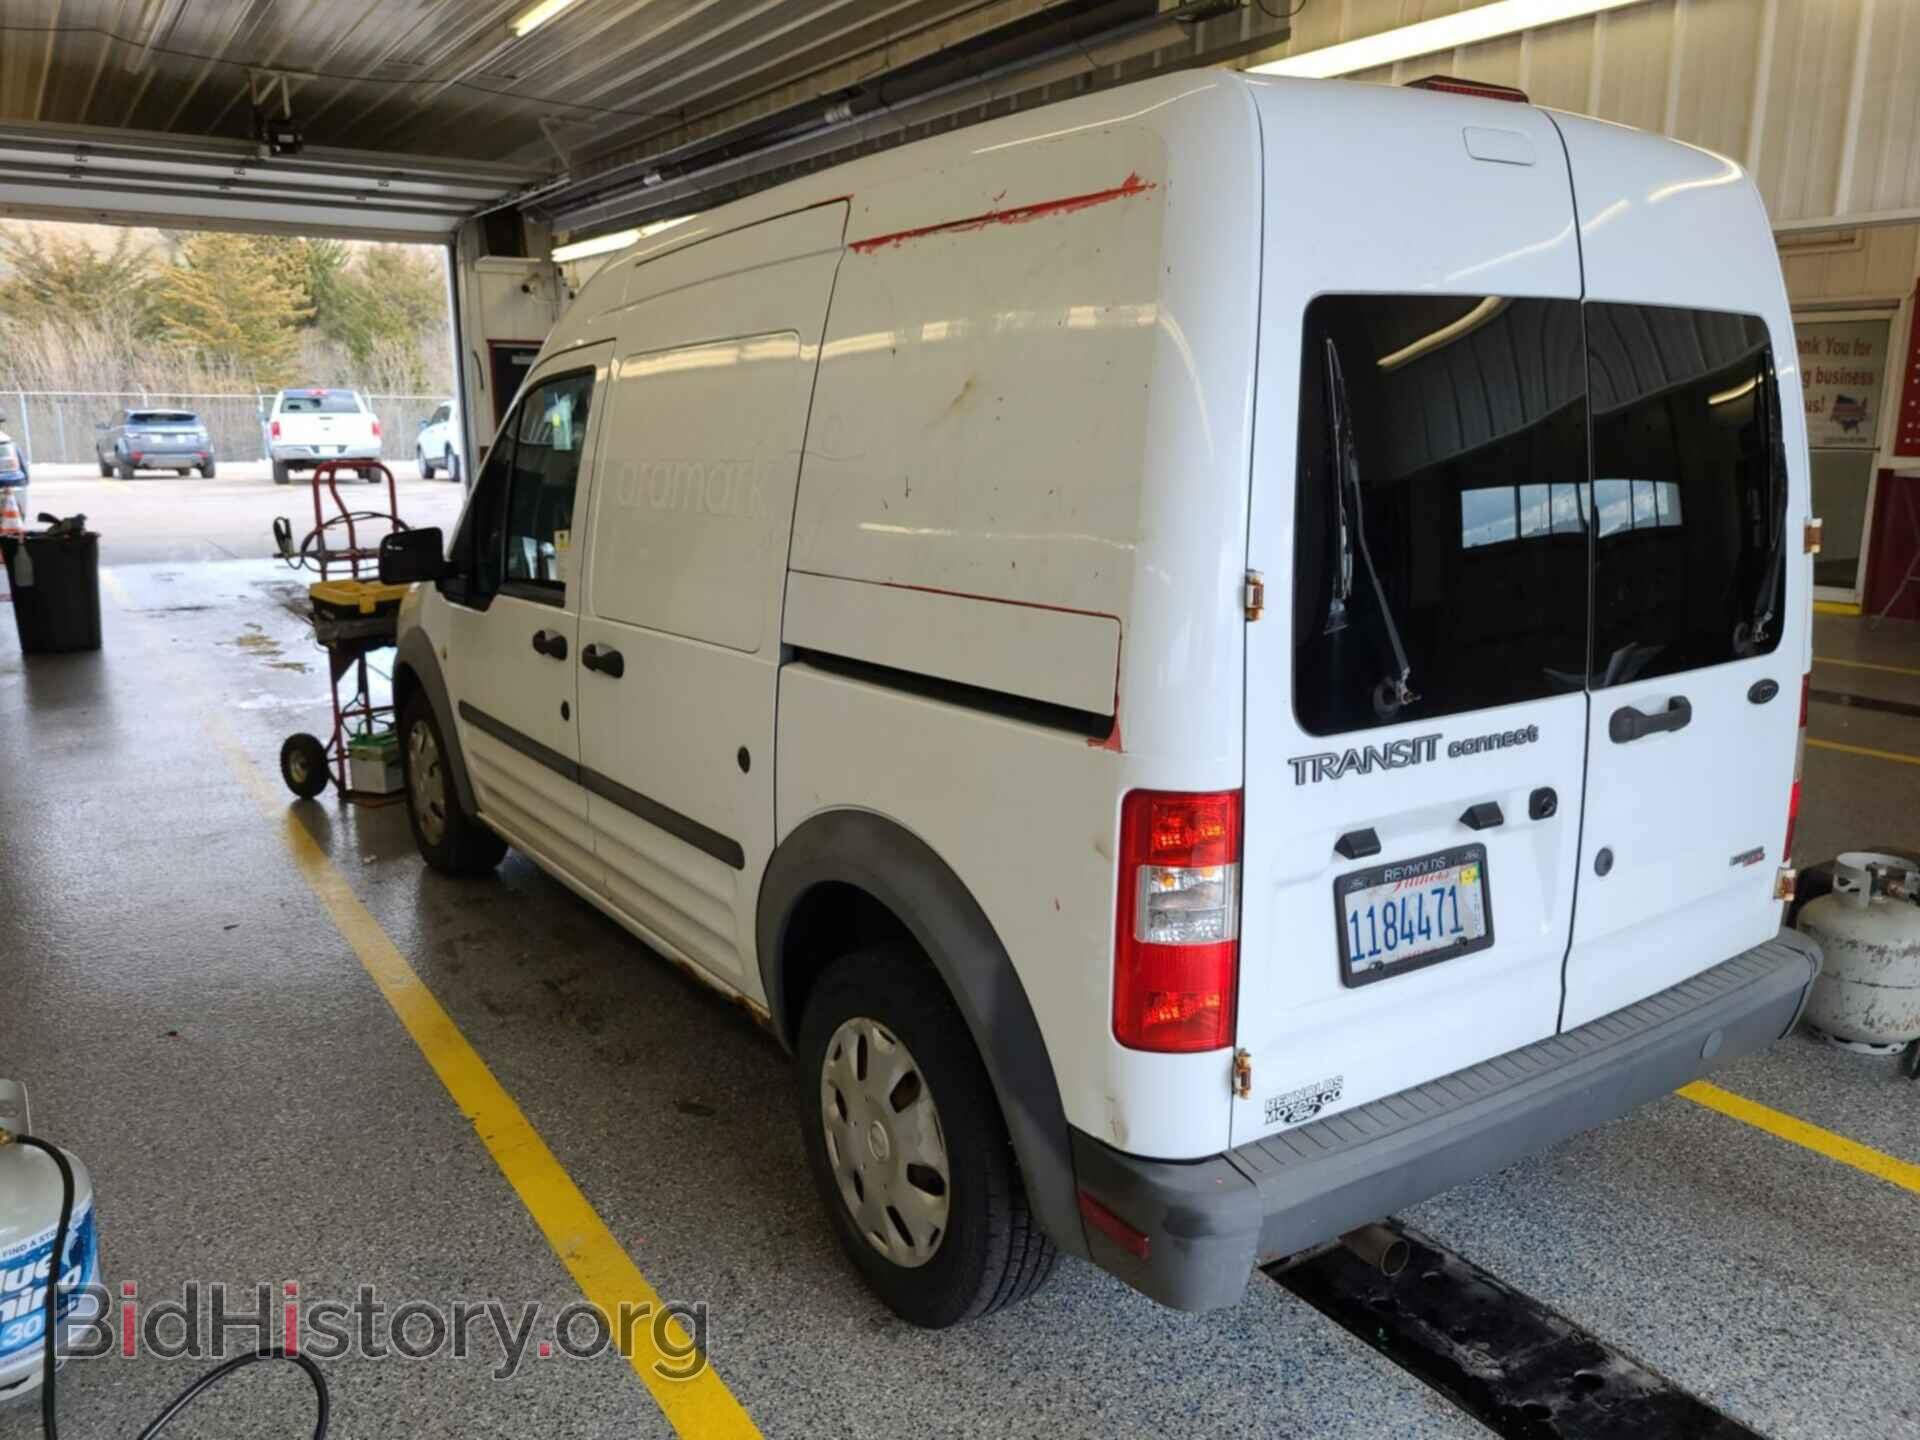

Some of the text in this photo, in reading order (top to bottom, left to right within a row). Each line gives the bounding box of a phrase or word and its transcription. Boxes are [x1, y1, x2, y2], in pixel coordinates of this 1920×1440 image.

[1824, 336, 1850, 355] You
[1853, 338, 1873, 357] for
[1815, 365, 1875, 386] business
[1288, 724, 1540, 786] TRANSIT connect
[1384, 856, 1446, 883] REYNOLDS
[1350, 885, 1464, 962] 1184471
[3, 1315, 42, 1347] 30
